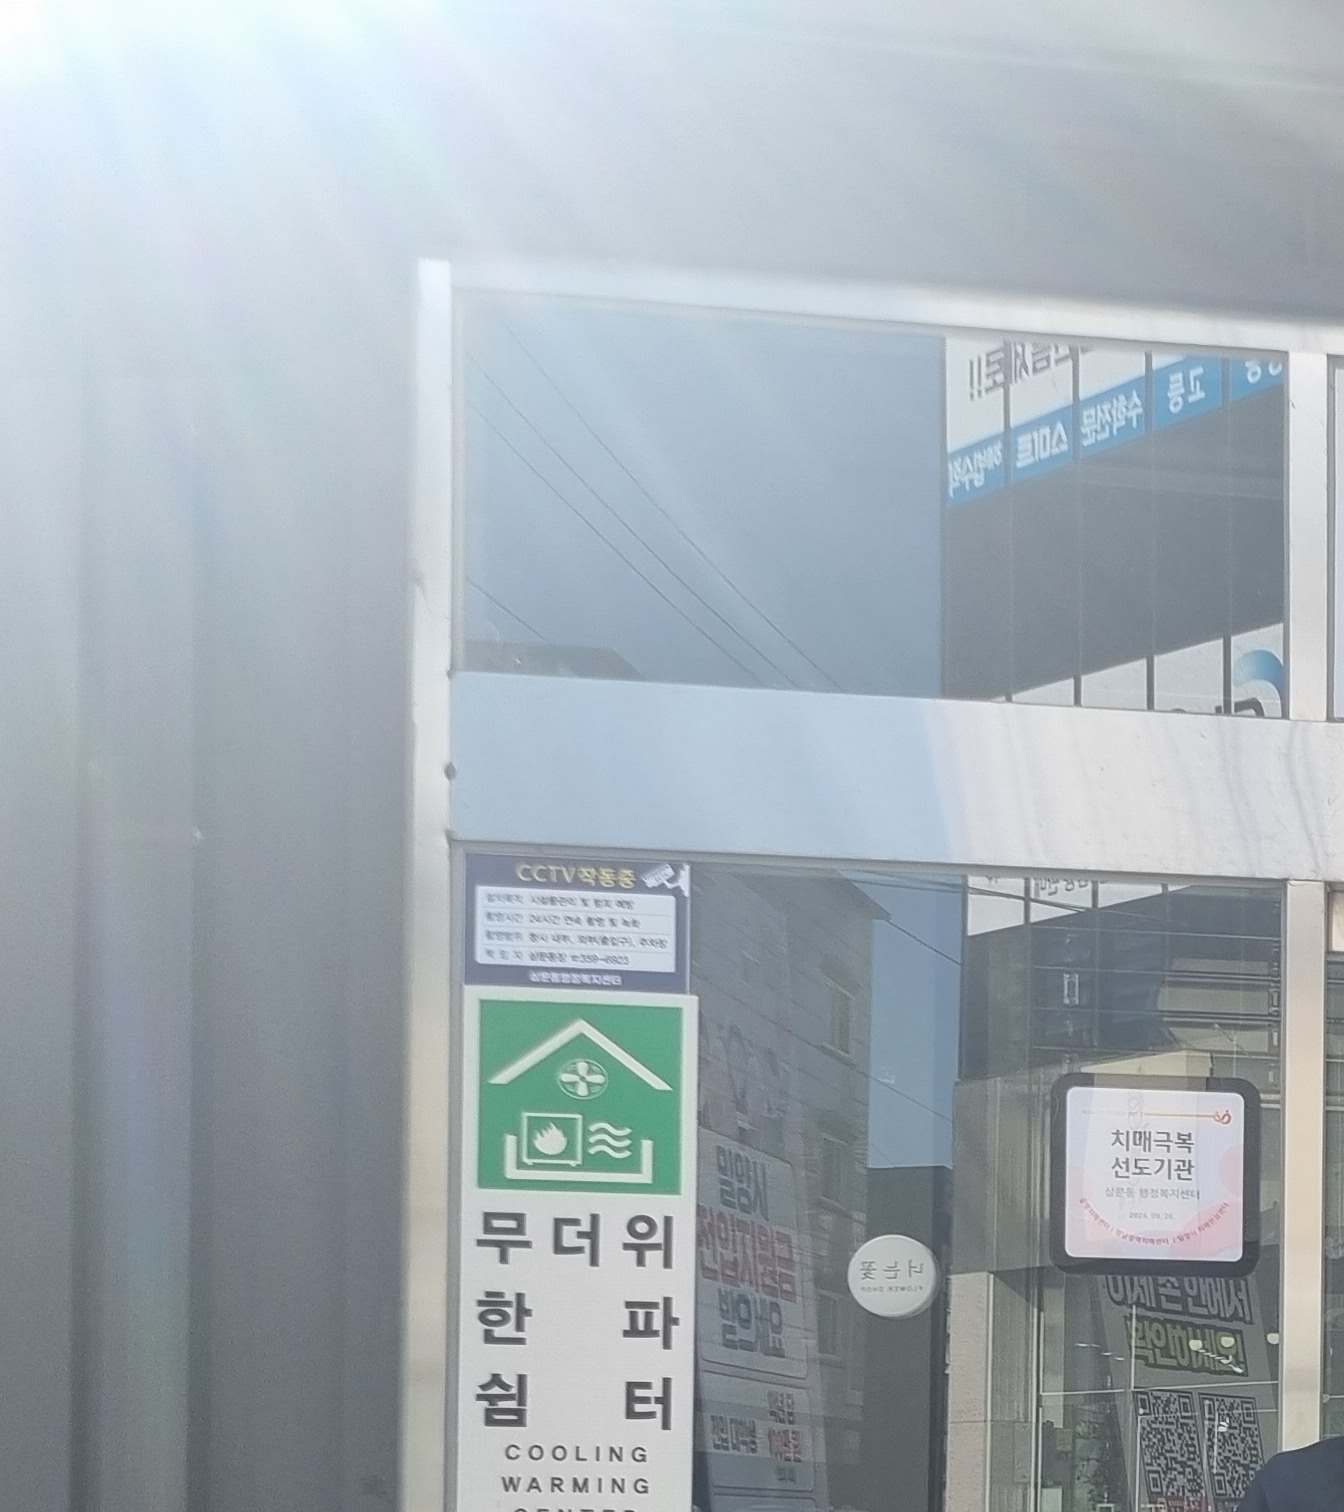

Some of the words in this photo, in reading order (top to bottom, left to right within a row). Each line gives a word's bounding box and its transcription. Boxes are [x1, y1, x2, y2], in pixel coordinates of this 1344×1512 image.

[1112, 1130, 1195, 1154] 치매극복
[1112, 1158, 1195, 1181] 선도기관
[476, 1212, 674, 1270] 무더위
[505, 1444, 648, 1463] COOLING
[501, 1476, 650, 1495] WARMING
